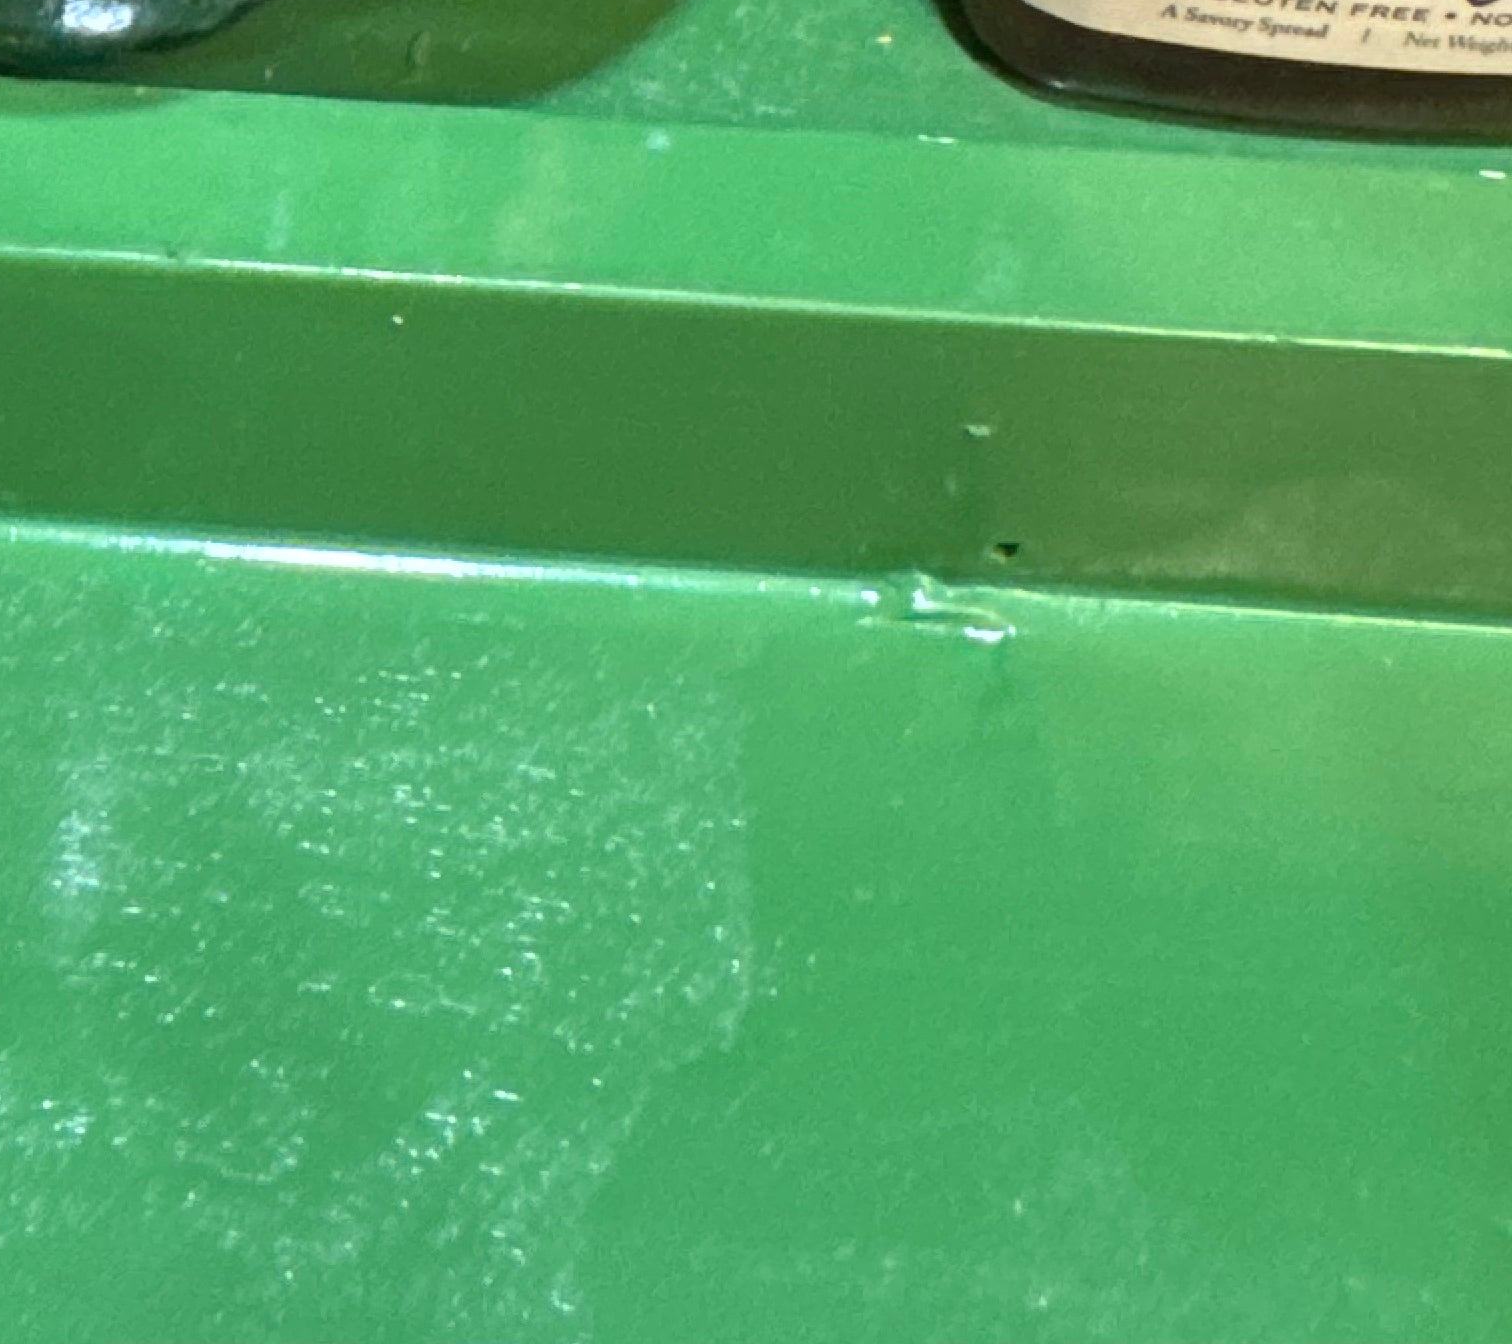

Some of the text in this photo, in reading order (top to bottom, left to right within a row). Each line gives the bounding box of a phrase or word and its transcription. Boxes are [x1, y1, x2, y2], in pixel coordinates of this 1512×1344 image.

[1160, 2, 1178, 19] A
[1184, 4, 1256, 32] Savory
[1258, 16, 1330, 40] Spread
[1349, 2, 1431, 24] FREE
